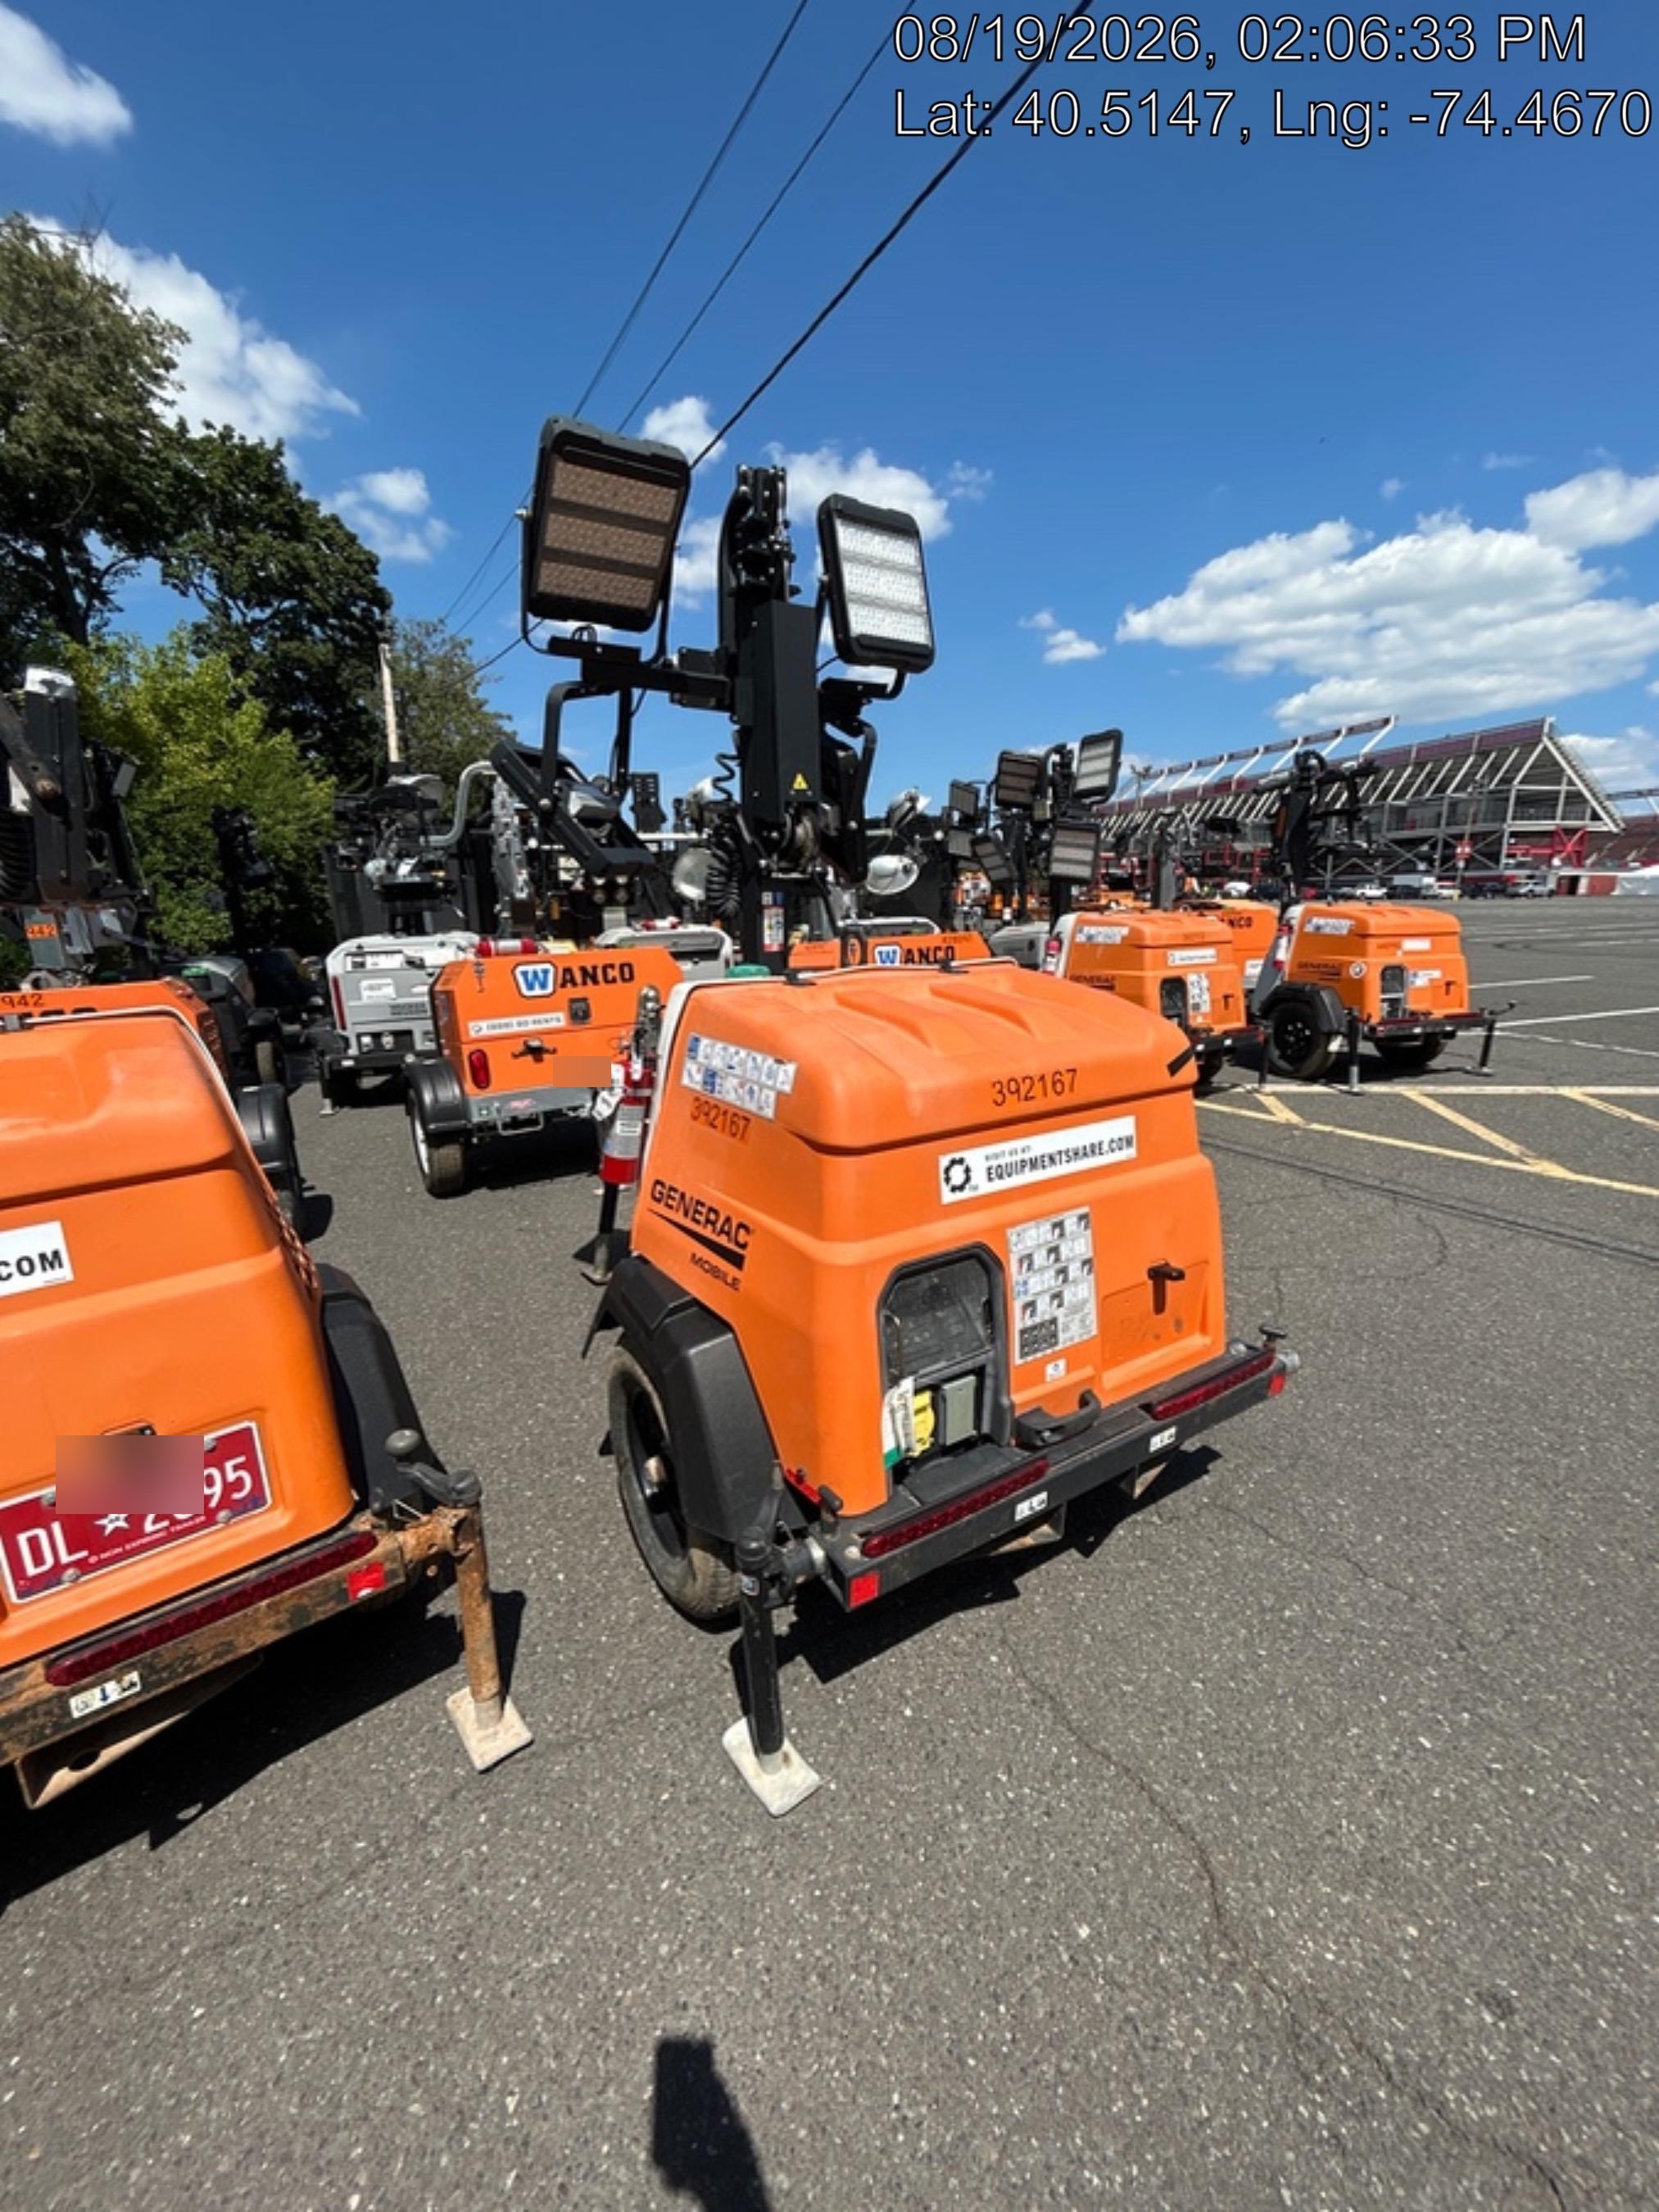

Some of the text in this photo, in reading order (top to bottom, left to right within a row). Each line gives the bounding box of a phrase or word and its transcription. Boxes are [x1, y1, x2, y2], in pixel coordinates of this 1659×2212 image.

[519, 962, 634, 990] WANCO
[992, 1068, 1077, 1106] 392167
[690, 1097, 751, 1143] 392167
[986, 1135, 1134, 1182] EQUIPMENTSHARE.COM
[650, 1178, 751, 1250] GENERAC
[690, 1253, 741, 1292] MOBILE
[17, 1521, 88, 1577] DL
